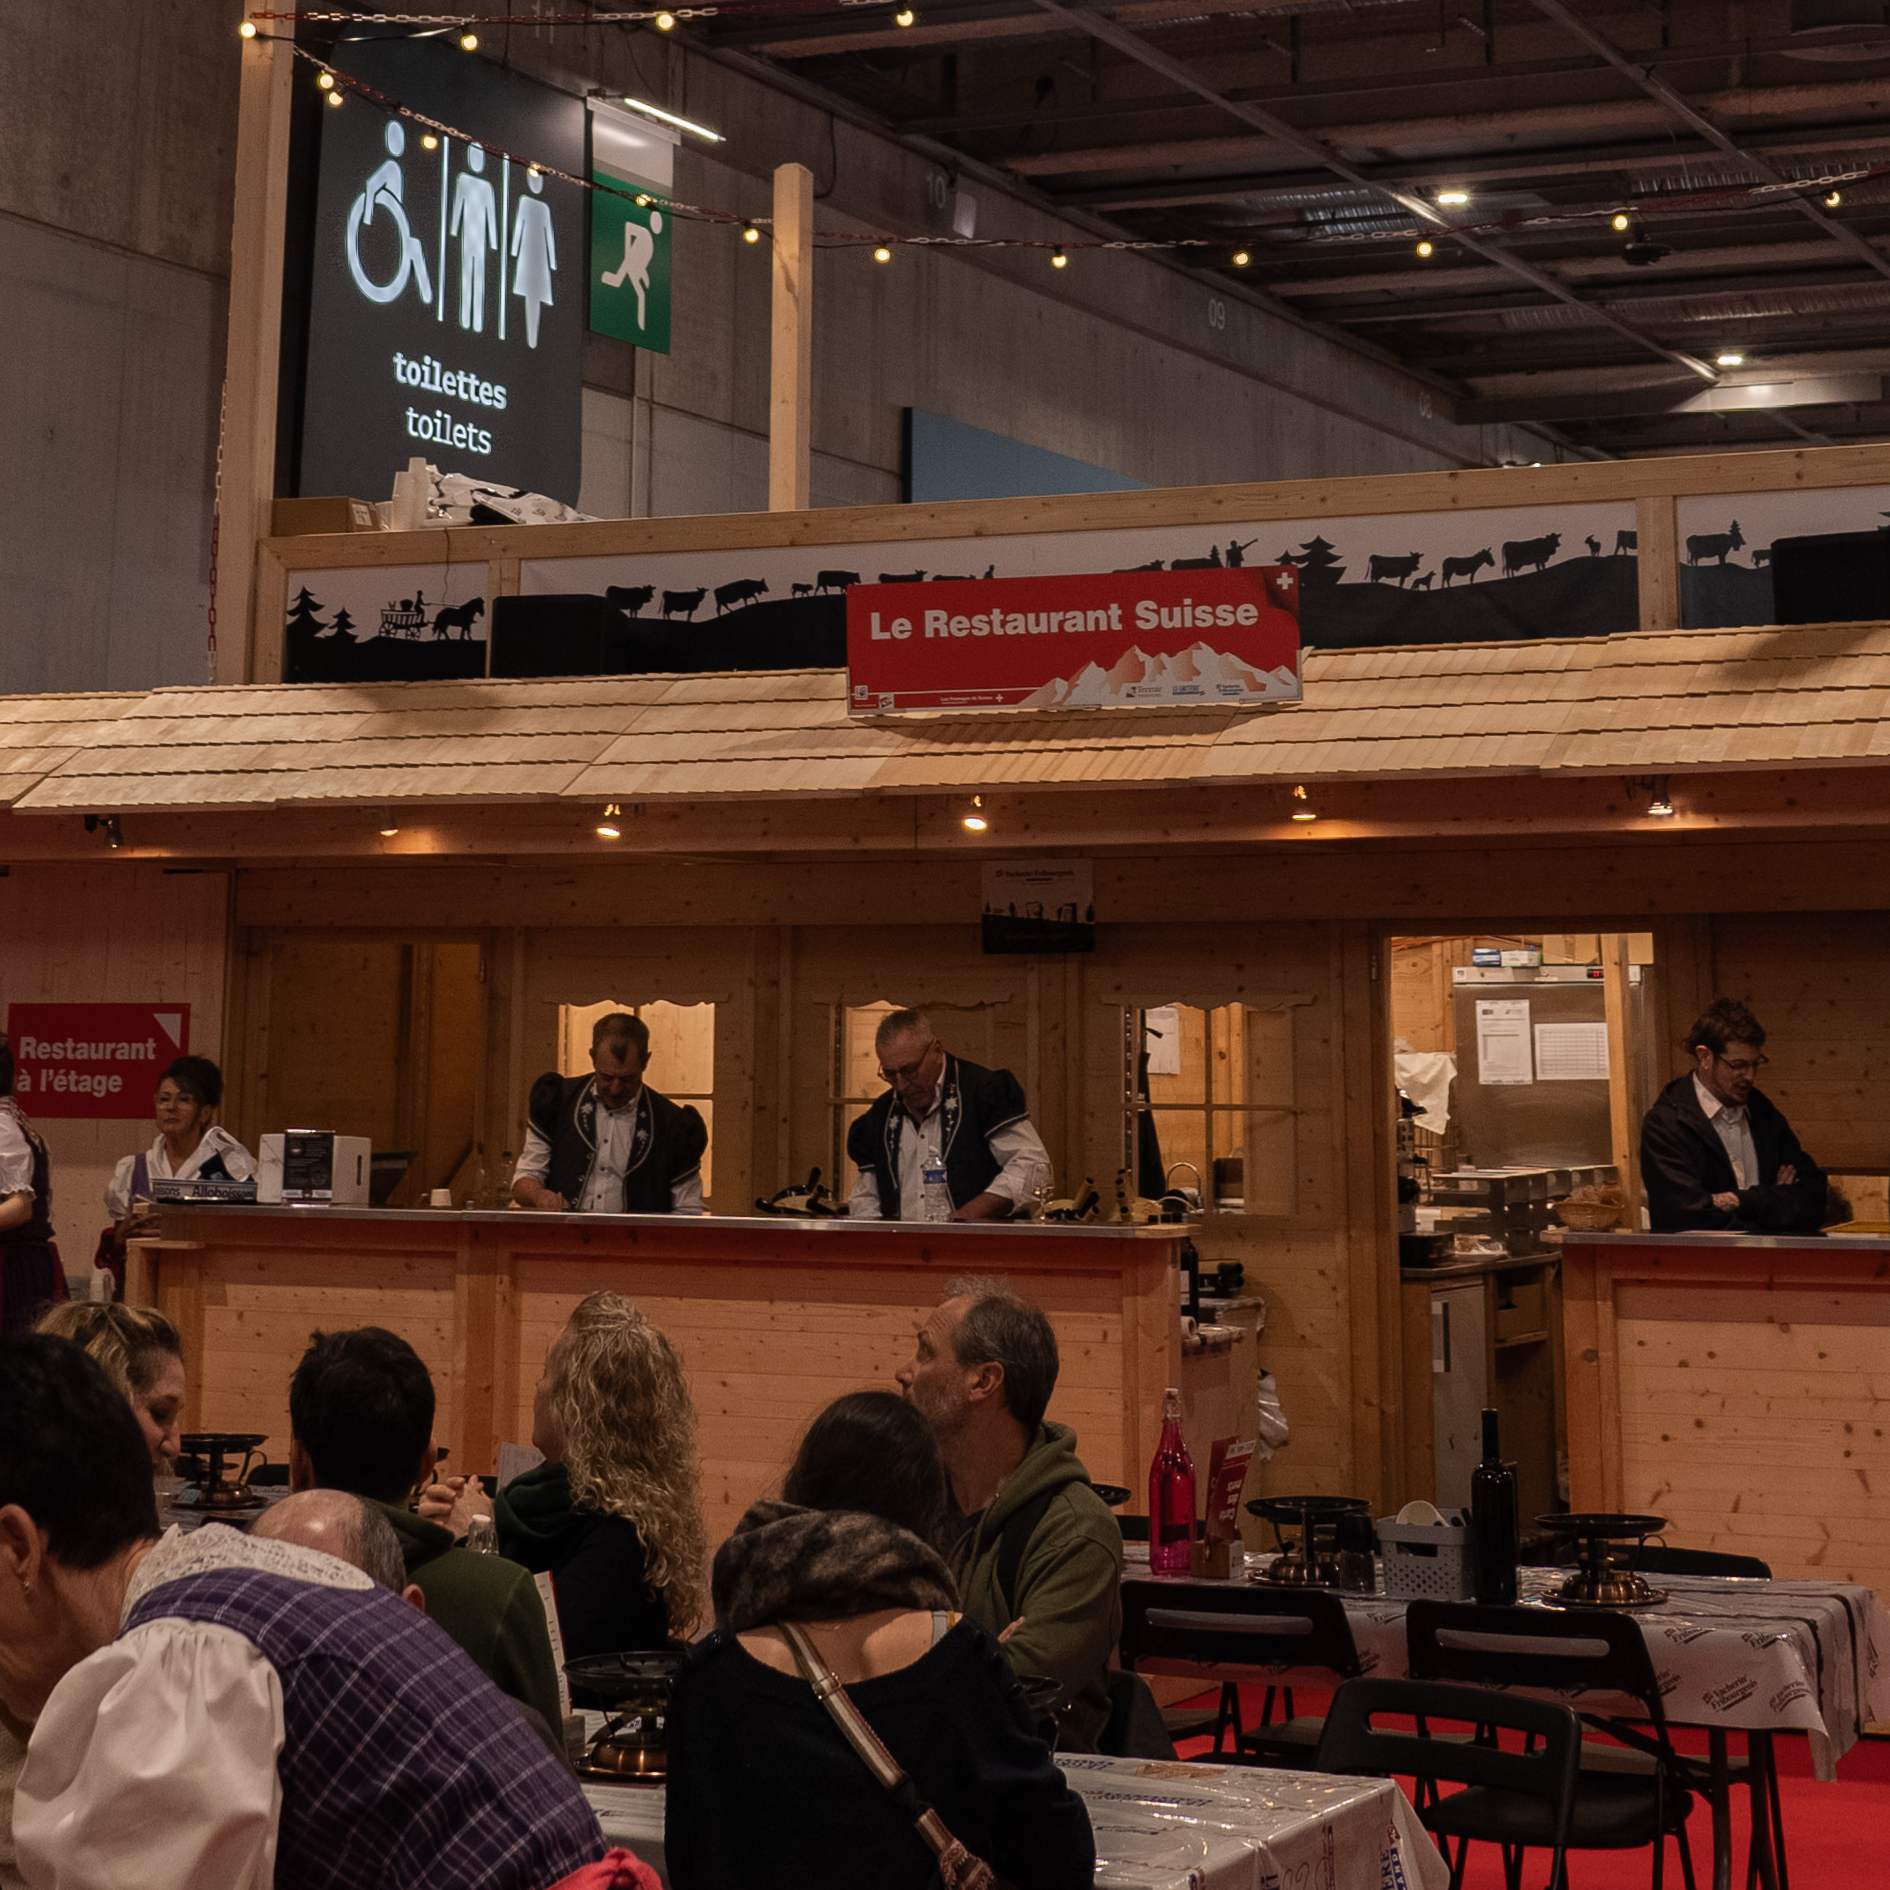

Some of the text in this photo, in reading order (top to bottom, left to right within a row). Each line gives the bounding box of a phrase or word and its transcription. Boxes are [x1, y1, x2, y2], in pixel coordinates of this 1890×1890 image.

[392, 351, 508, 410] toilettes
[405, 406, 492, 455] toilets
[870, 598, 1260, 642] Le Restaurant Suisse
[19, 1036, 157, 1061] Restaurant
[17, 1068, 123, 1098] à l'étage
